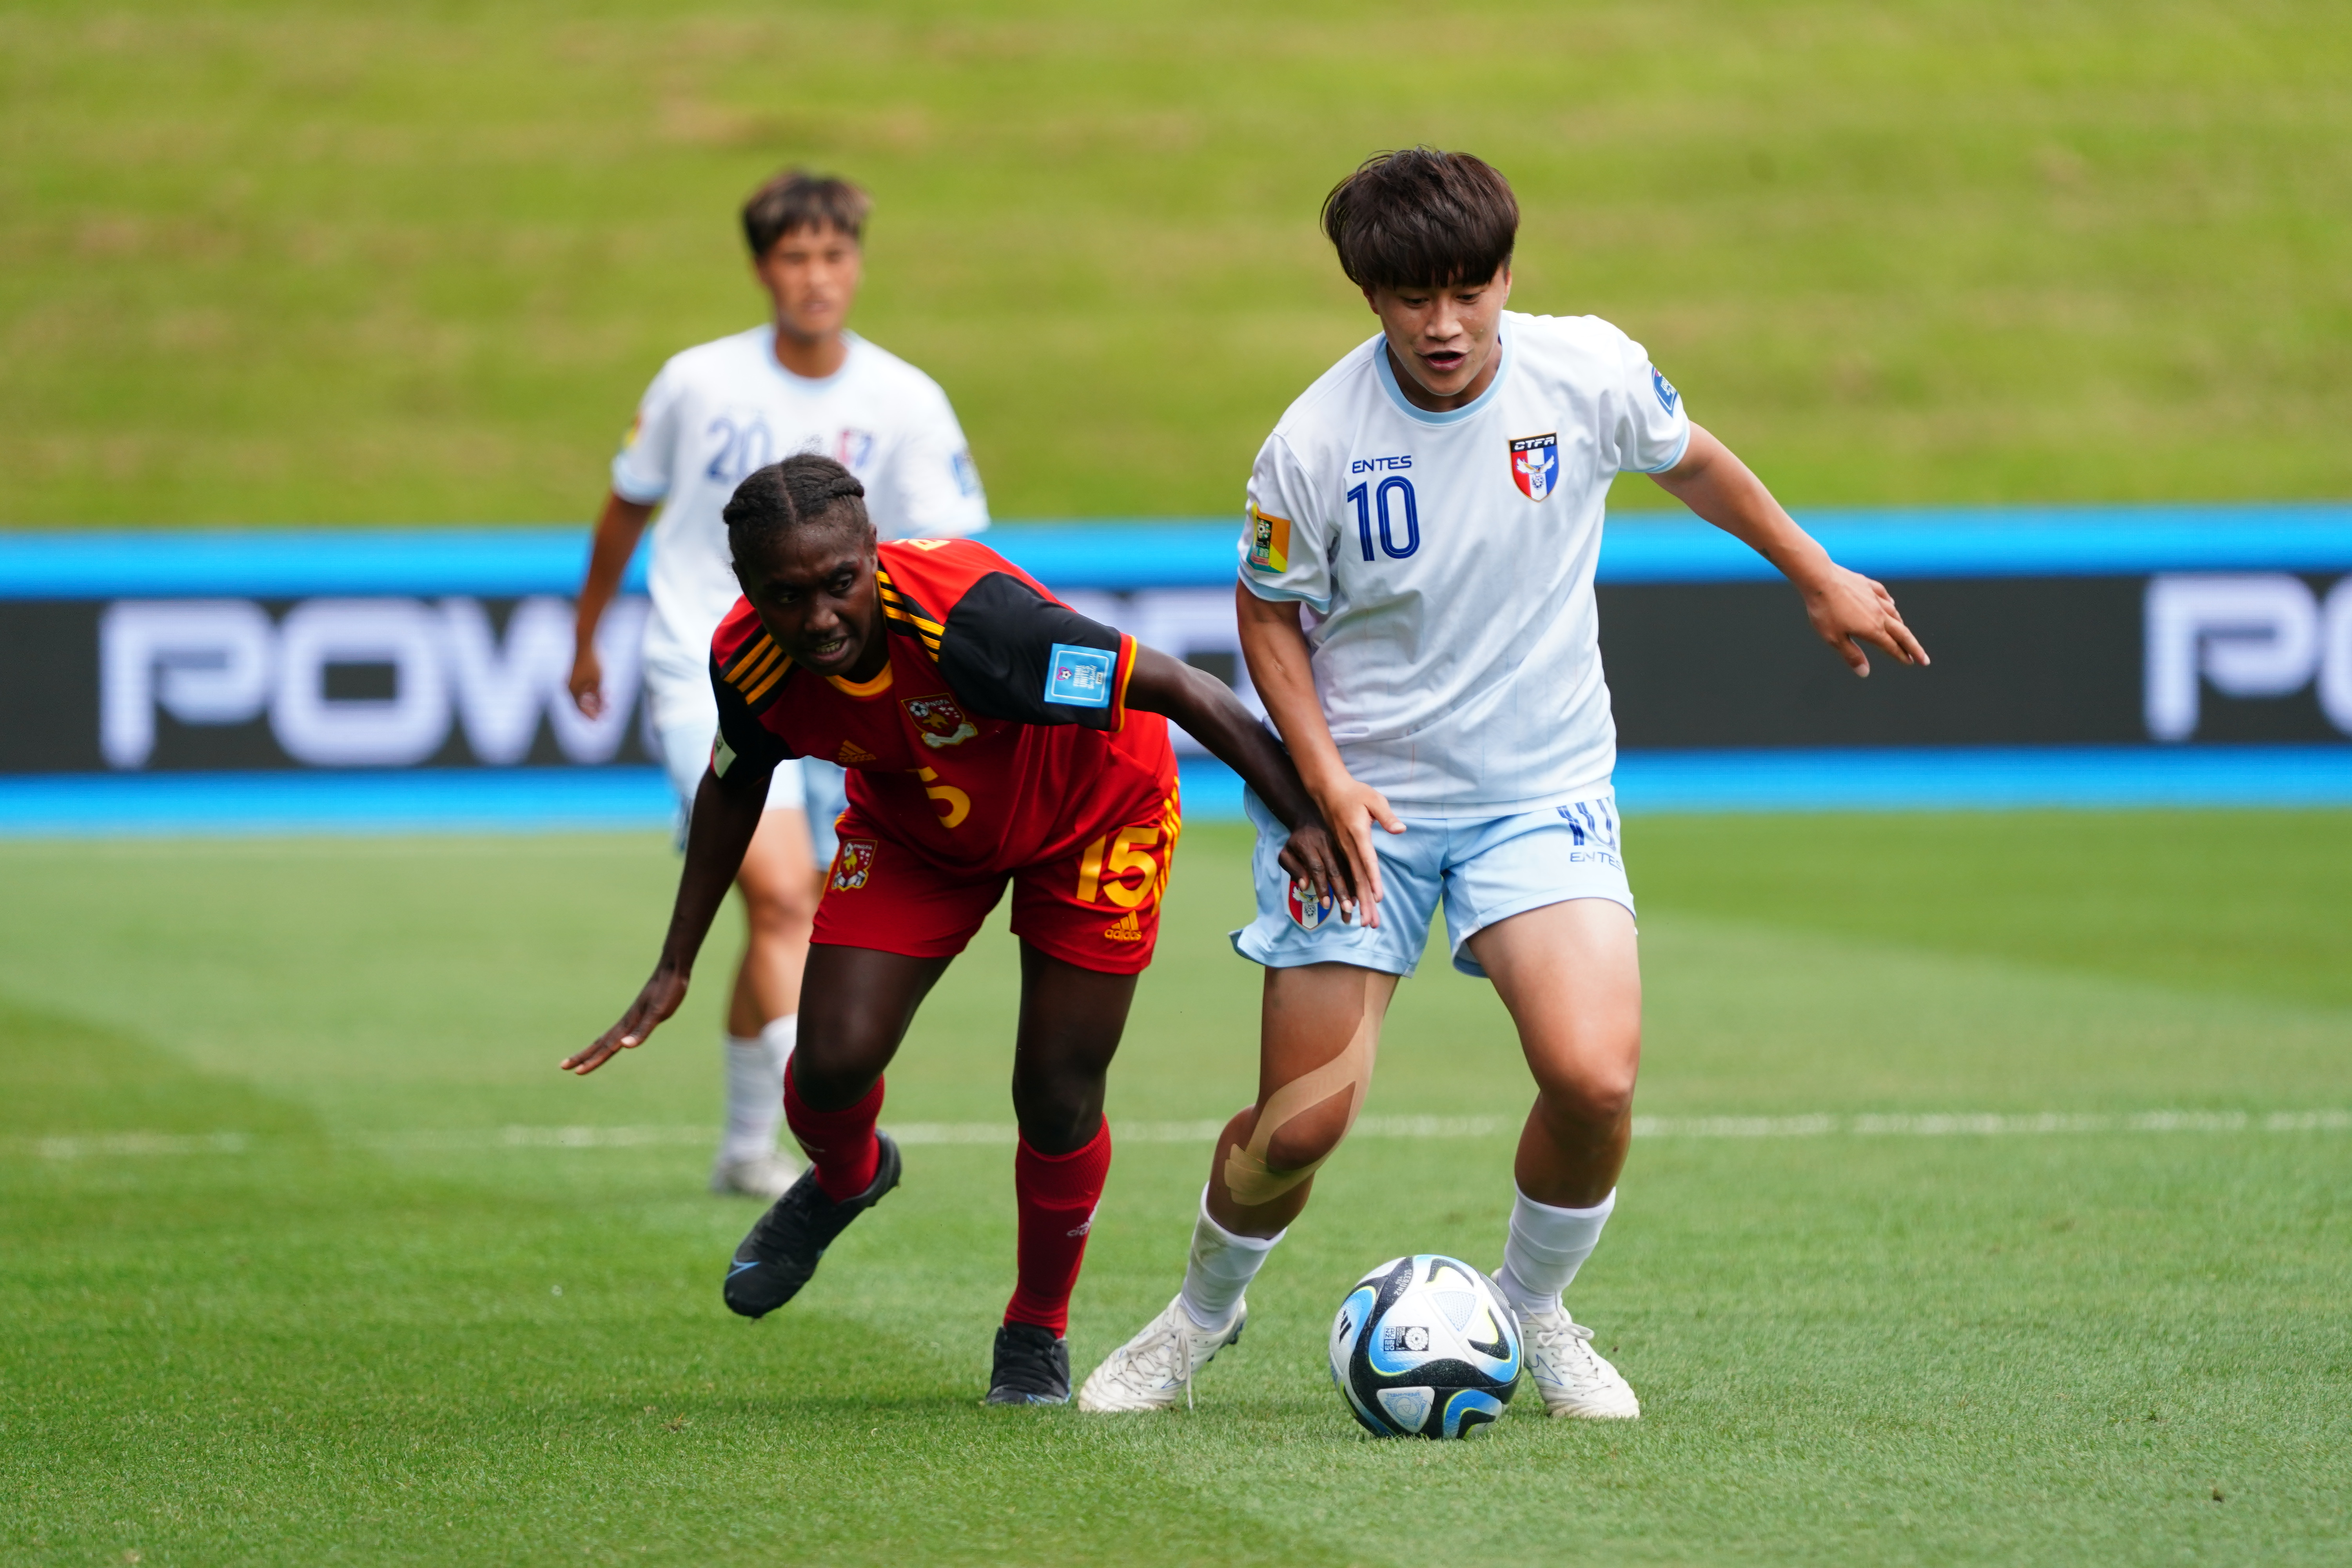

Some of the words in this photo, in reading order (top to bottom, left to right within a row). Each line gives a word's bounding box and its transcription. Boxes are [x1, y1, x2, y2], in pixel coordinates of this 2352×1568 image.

[705, 416, 772, 485] 20
[1352, 455, 1412, 474] ENTES
[1514, 436, 1555, 450] CTFA
[1347, 475, 1420, 561] 10
[2142, 572, 2352, 743] P
[100, 597, 664, 768] POW
[838, 753, 877, 762] adidas
[1076, 826, 1160, 908] 15
[1570, 851, 1622, 871] ENTES
[1104, 929, 1142, 941] adidas
